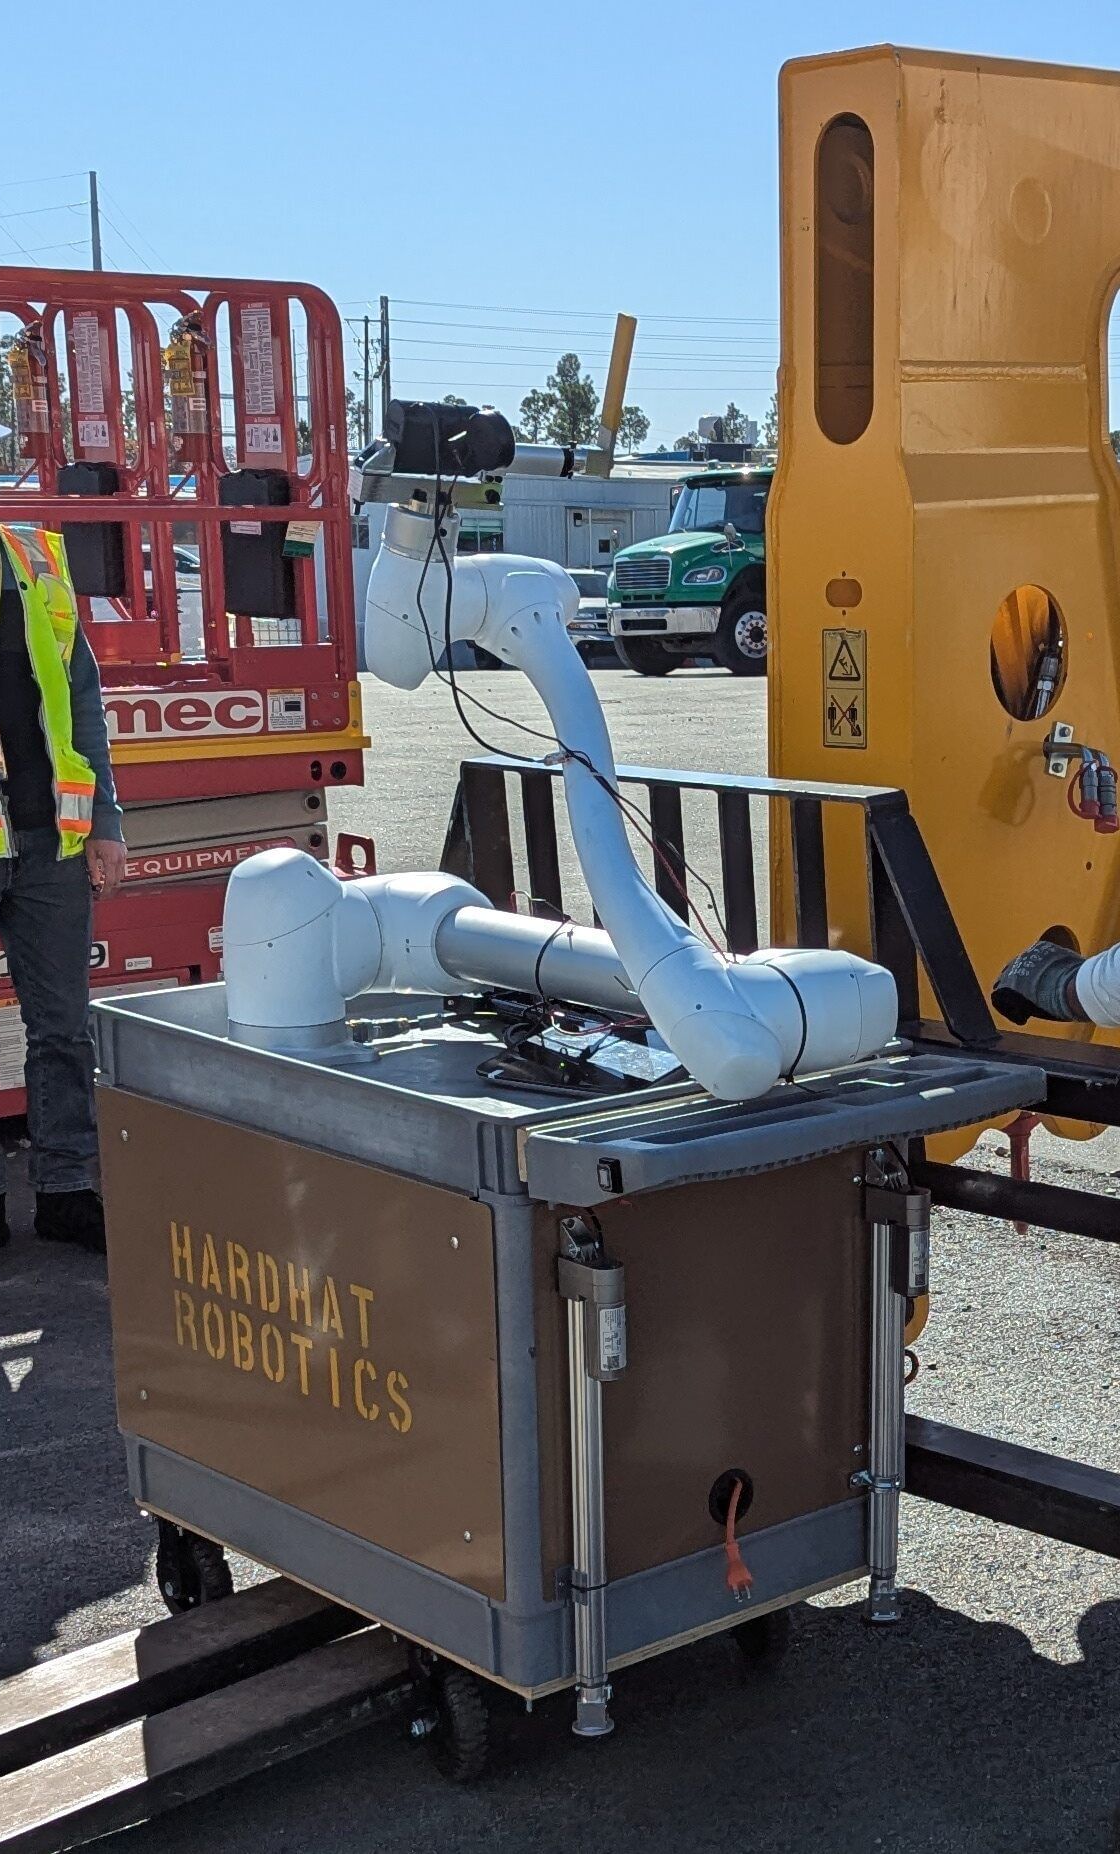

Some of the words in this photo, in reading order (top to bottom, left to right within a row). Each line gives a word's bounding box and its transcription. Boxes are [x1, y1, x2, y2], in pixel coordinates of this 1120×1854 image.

[104, 696, 261, 734] mec
[124, 841, 288, 877] EQUIPME
[169, 1220, 375, 1349] HARDHAT
[174, 1288, 413, 1434] ROBOTICS
